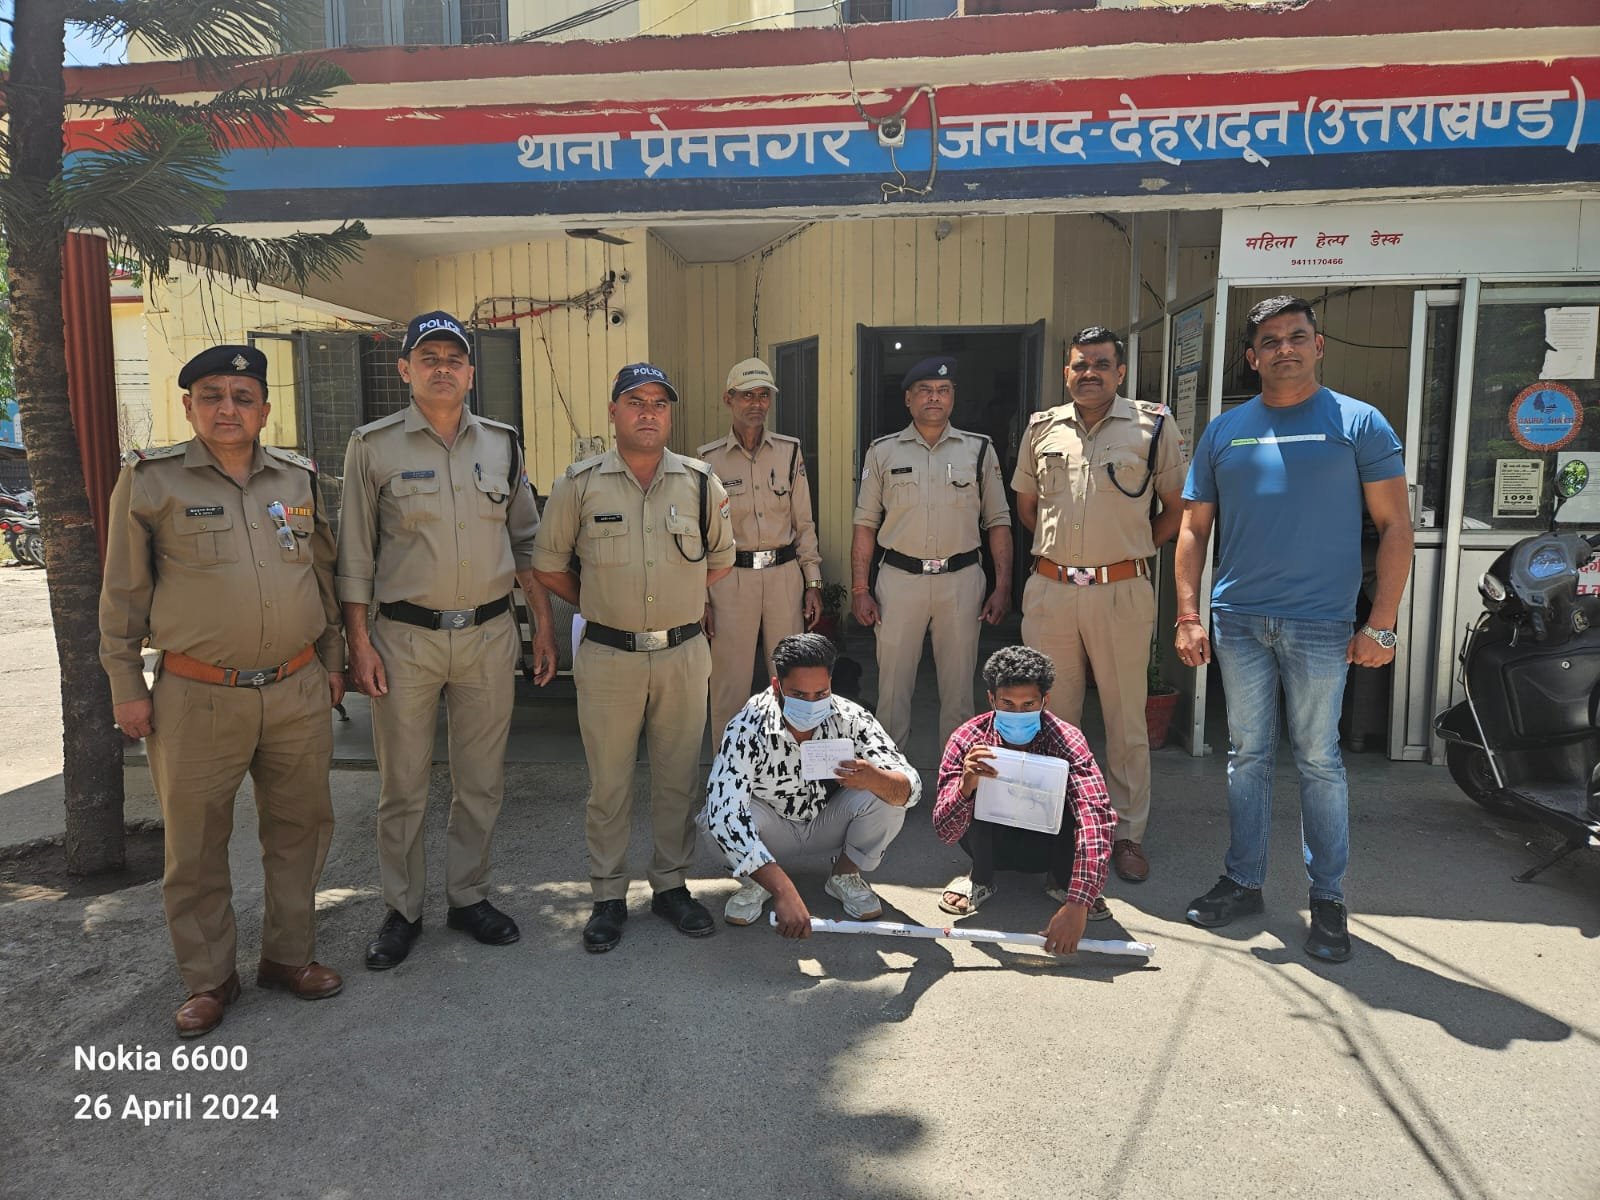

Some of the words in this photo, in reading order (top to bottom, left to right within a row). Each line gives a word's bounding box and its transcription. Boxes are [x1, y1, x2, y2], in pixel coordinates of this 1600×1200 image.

[517, 131, 620, 172] थाना
[631, 113, 869, 178] प्रेमनगर
[1245, 232, 1298, 252] महिला
[1316, 232, 1349, 249] हेल्प
[1370, 230, 1404, 247] डेस्क
[1291, 258, 1344, 266] 9411170466
